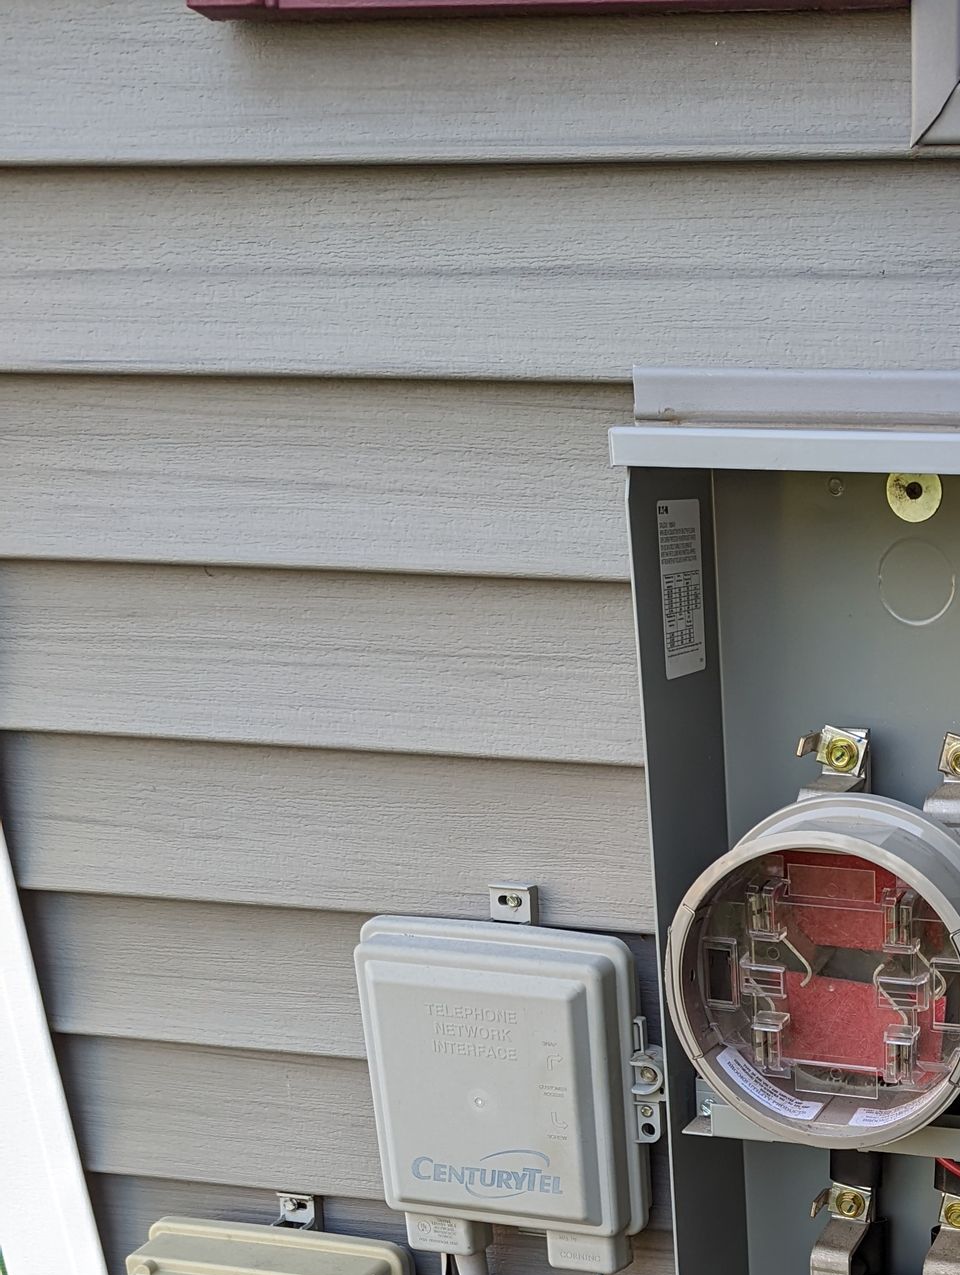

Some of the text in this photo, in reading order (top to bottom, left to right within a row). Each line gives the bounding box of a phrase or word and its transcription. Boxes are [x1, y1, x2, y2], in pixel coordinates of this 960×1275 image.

[424, 1004, 517, 1024] TELEPHONE
[435, 1022, 513, 1042] NETWORK
[433, 1040, 517, 1061] INTERFACE
